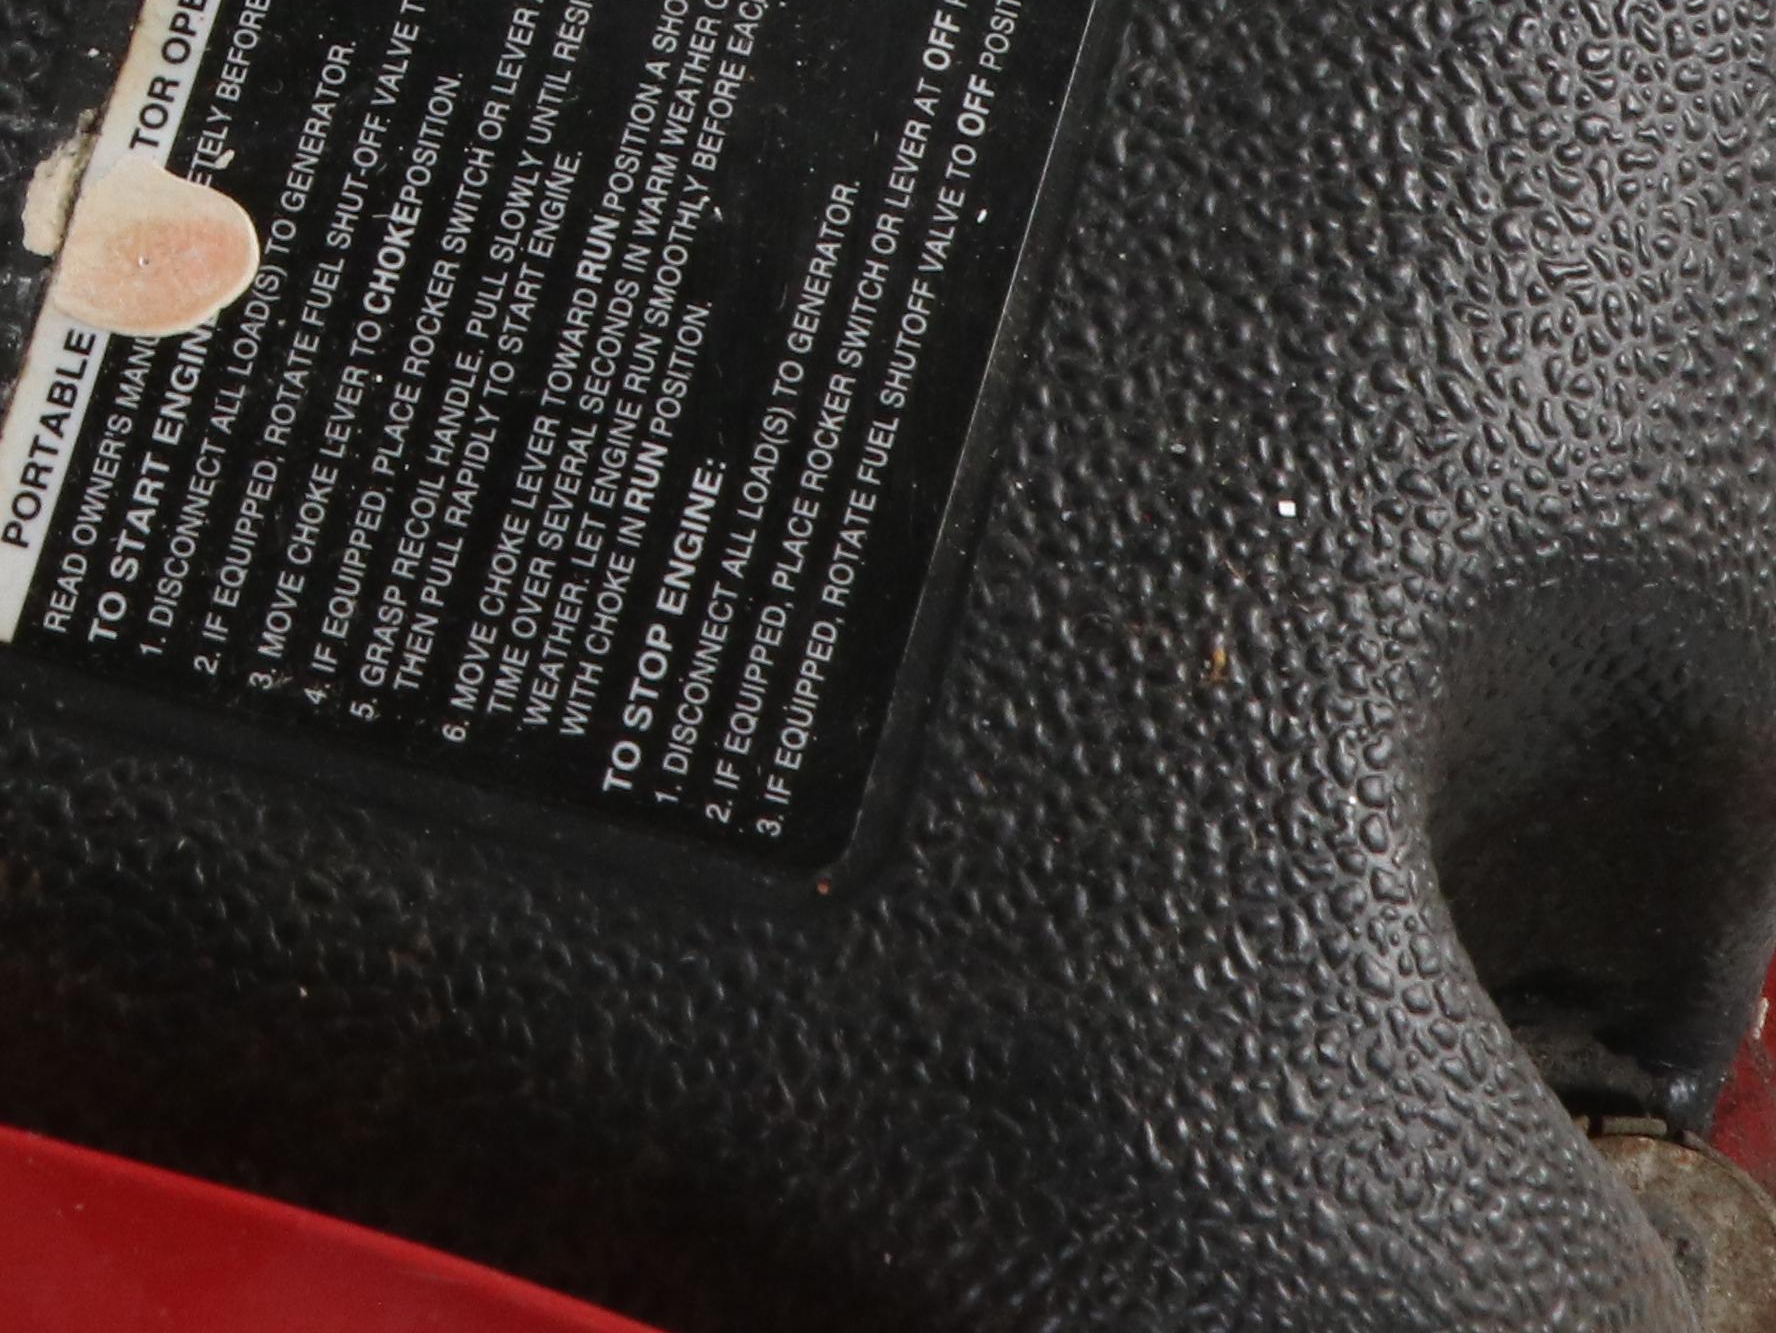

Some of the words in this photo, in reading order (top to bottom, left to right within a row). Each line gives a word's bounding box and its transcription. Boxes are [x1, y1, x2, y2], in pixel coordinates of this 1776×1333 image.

[786, 180, 860, 353] GENERATOR.
[0, 328, 96, 548] PORTABLE
[736, 406, 795, 520] LOAD(S)
[771, 360, 804, 396] TO
[87, 591, 127, 641] TO
[109, 450, 170, 581] START
[601, 740, 641, 791] TO
[622, 623, 672, 730] STOP
[655, 458, 726, 615] ENGINE:
[720, 528, 756, 578] ALL
[661, 580, 738, 774] DISCONNECT
[654, 785, 682, 802] 1.
